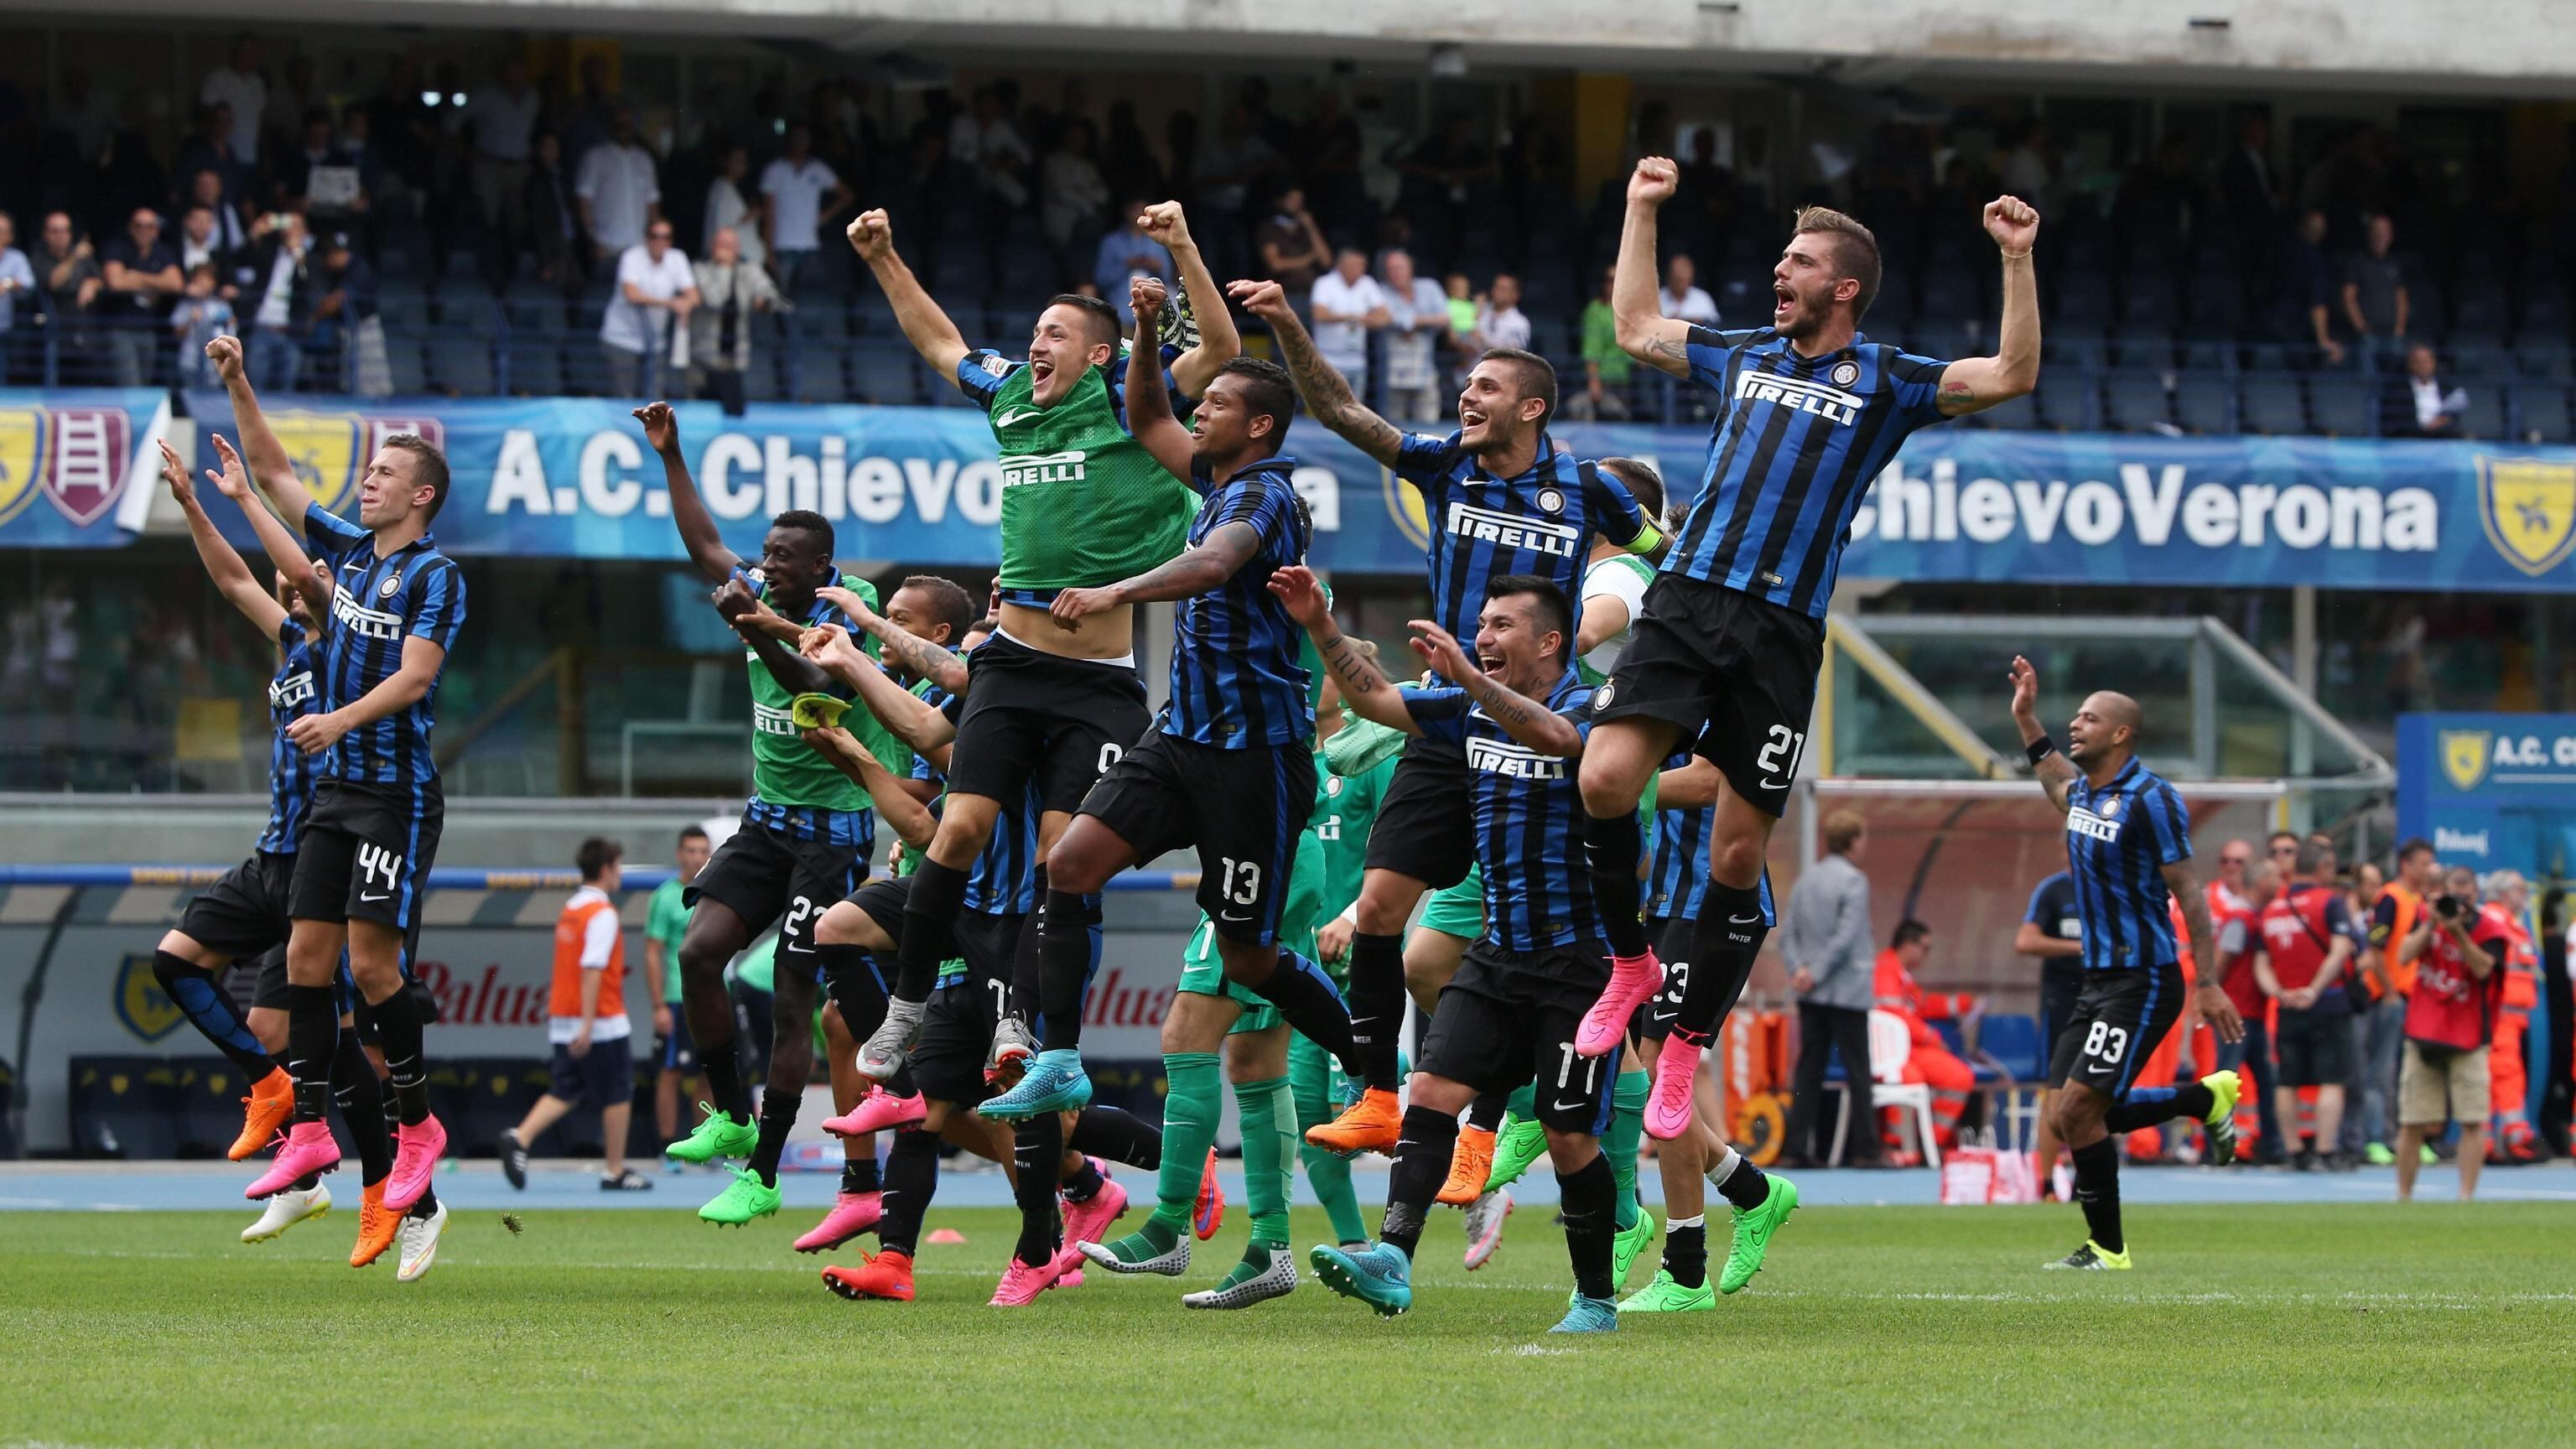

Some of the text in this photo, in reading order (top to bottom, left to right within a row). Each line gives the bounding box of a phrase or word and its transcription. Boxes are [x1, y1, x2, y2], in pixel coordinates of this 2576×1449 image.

[1735, 370, 1863, 427] PIRELLI
[488, 430, 672, 517] A.C.
[1447, 501, 1579, 558] PIRELLI
[333, 583, 403, 641] PIRELLI
[1465, 736, 1564, 779] PIRELLI
[1757, 724, 1805, 780] 21
[359, 842, 402, 891] 44
[1221, 856, 1261, 905] 13
[2084, 1020, 2128, 1064] 83
